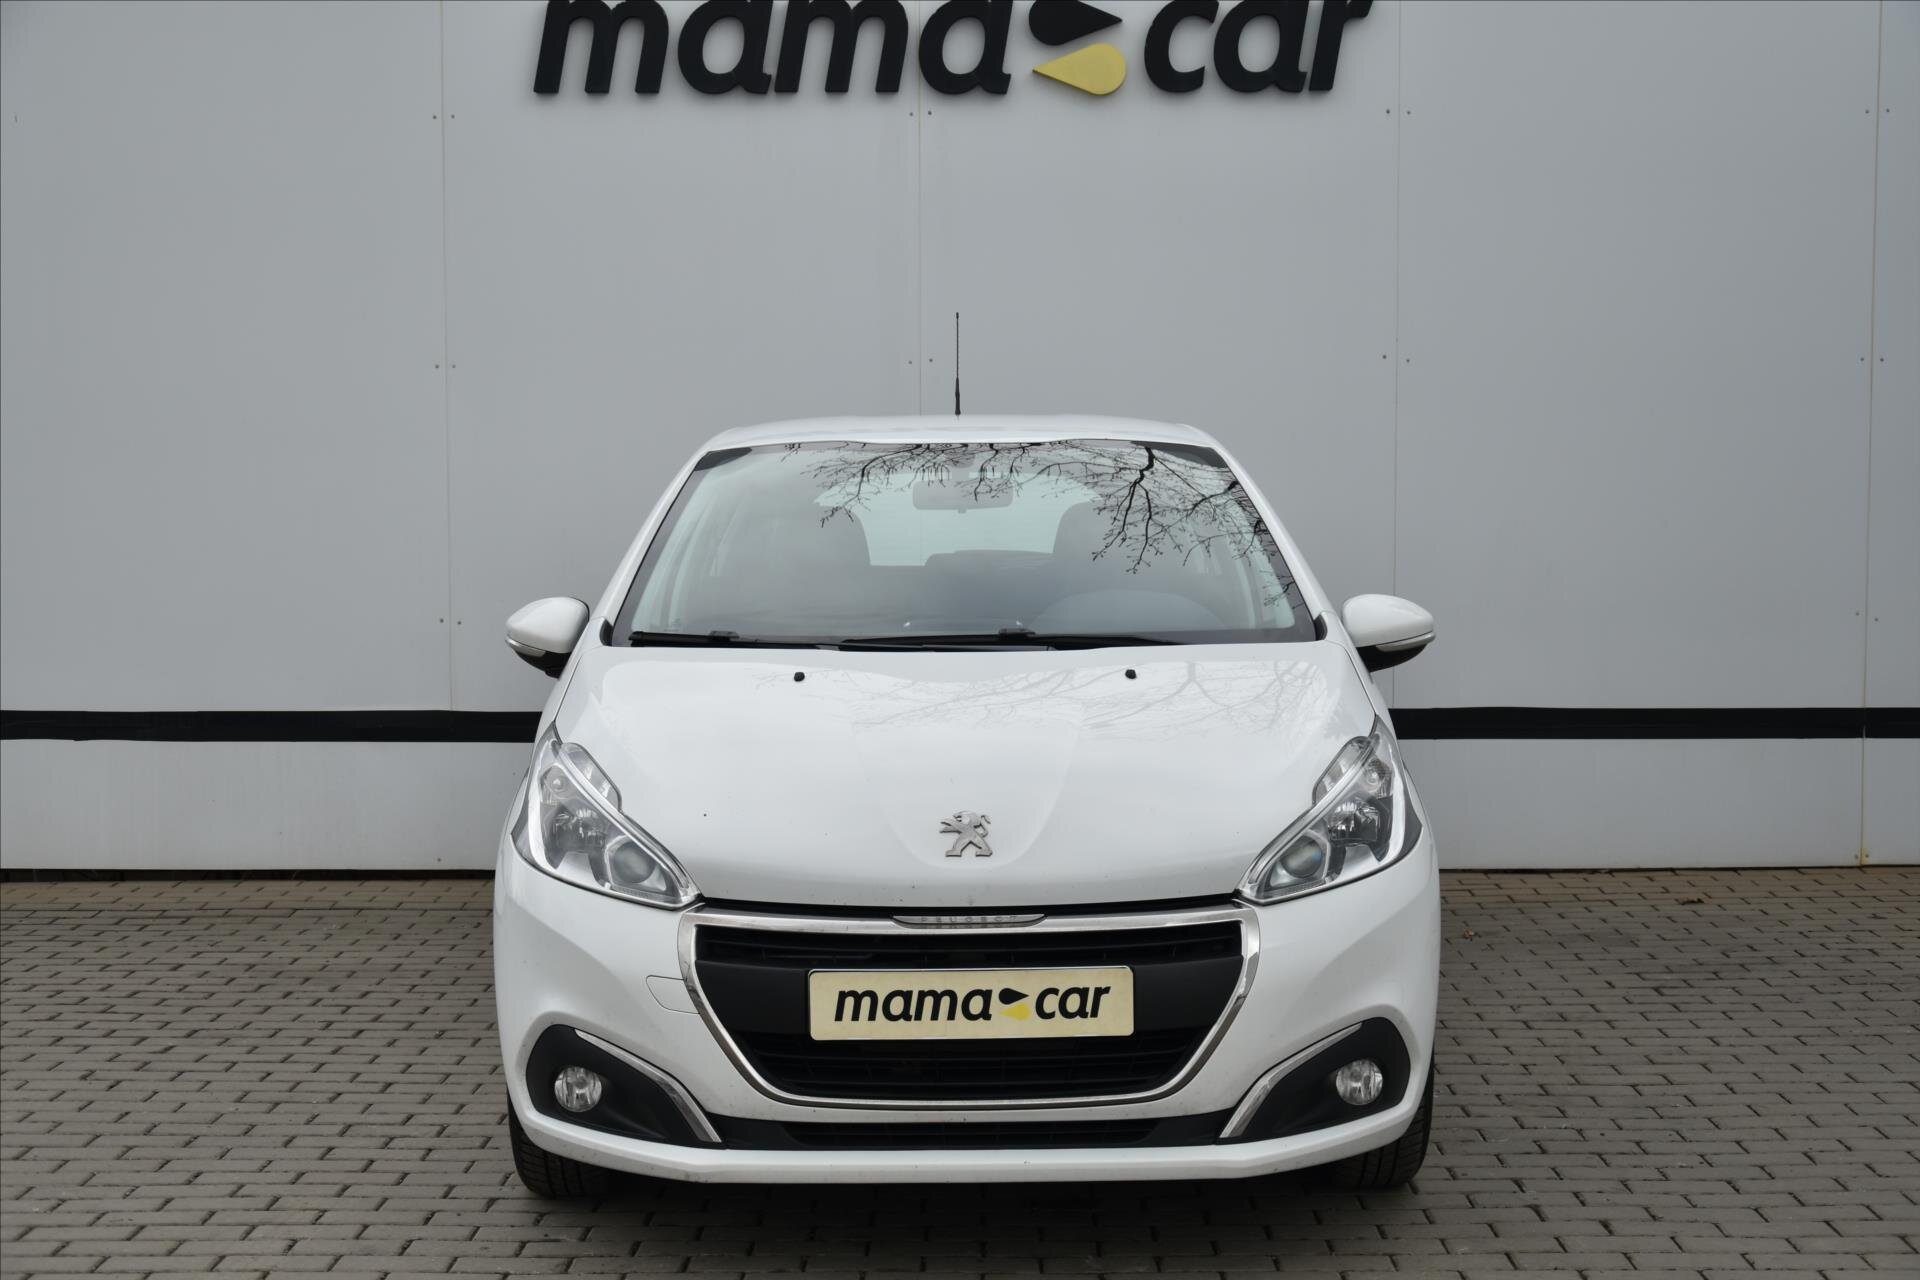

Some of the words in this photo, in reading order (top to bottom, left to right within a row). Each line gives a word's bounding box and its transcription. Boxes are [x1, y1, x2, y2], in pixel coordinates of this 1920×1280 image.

[534, 0, 1010, 94] mama
[1144, 0, 1373, 93] car
[834, 989, 993, 1022] mama
[1035, 986, 1111, 1020] car
